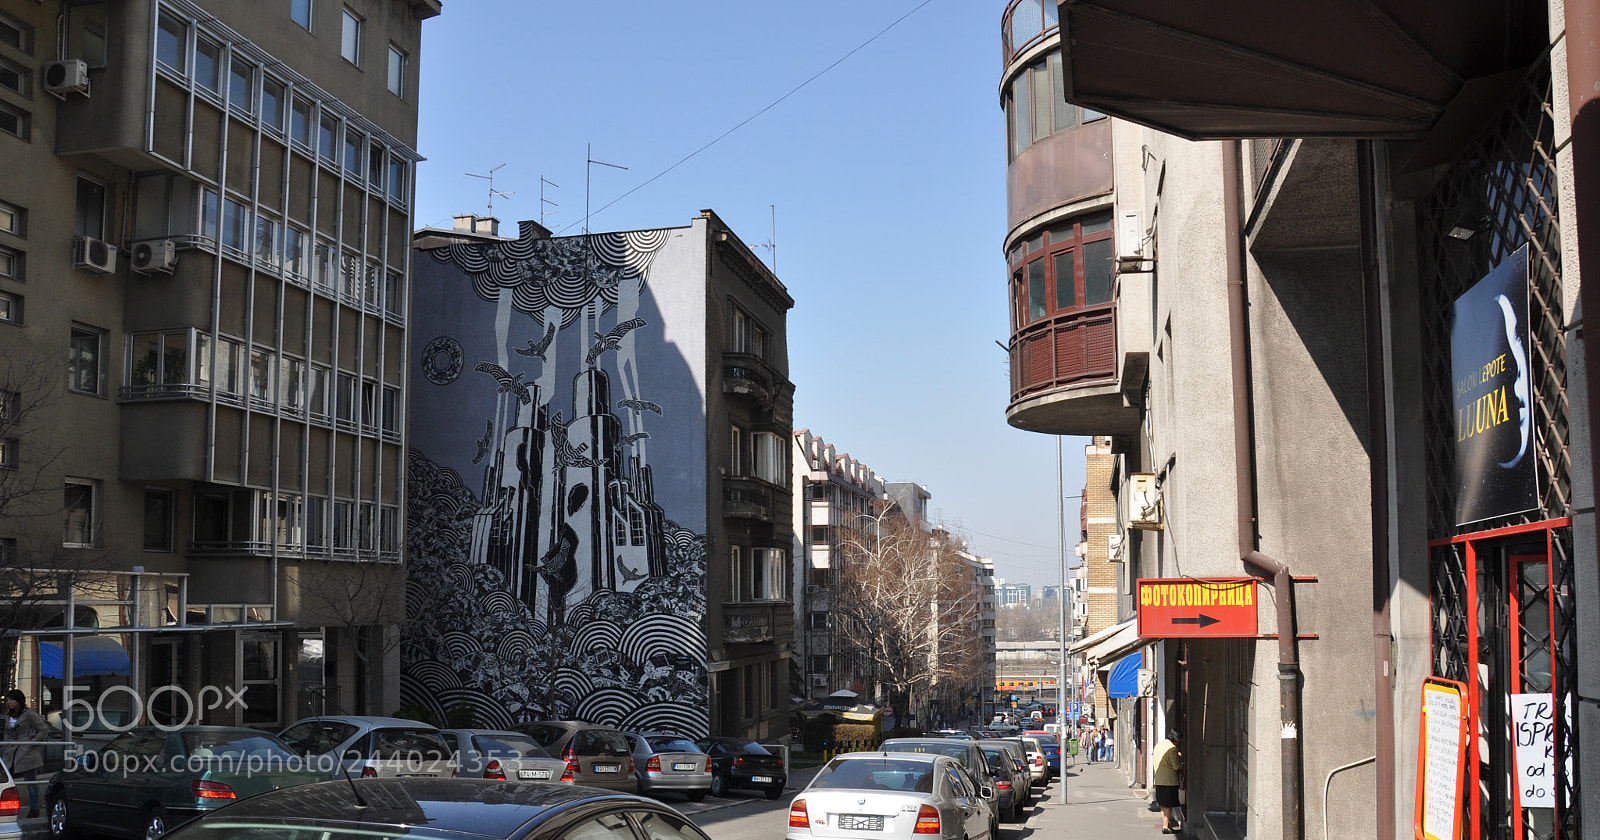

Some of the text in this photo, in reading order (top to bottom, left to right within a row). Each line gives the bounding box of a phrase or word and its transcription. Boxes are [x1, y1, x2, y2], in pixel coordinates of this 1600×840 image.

[1456, 353, 1506, 399] SALON LEPOTE
[1457, 385, 1510, 443] LUUNA
[1140, 583, 1253, 607] ФОТОКОПИРНИЦА
